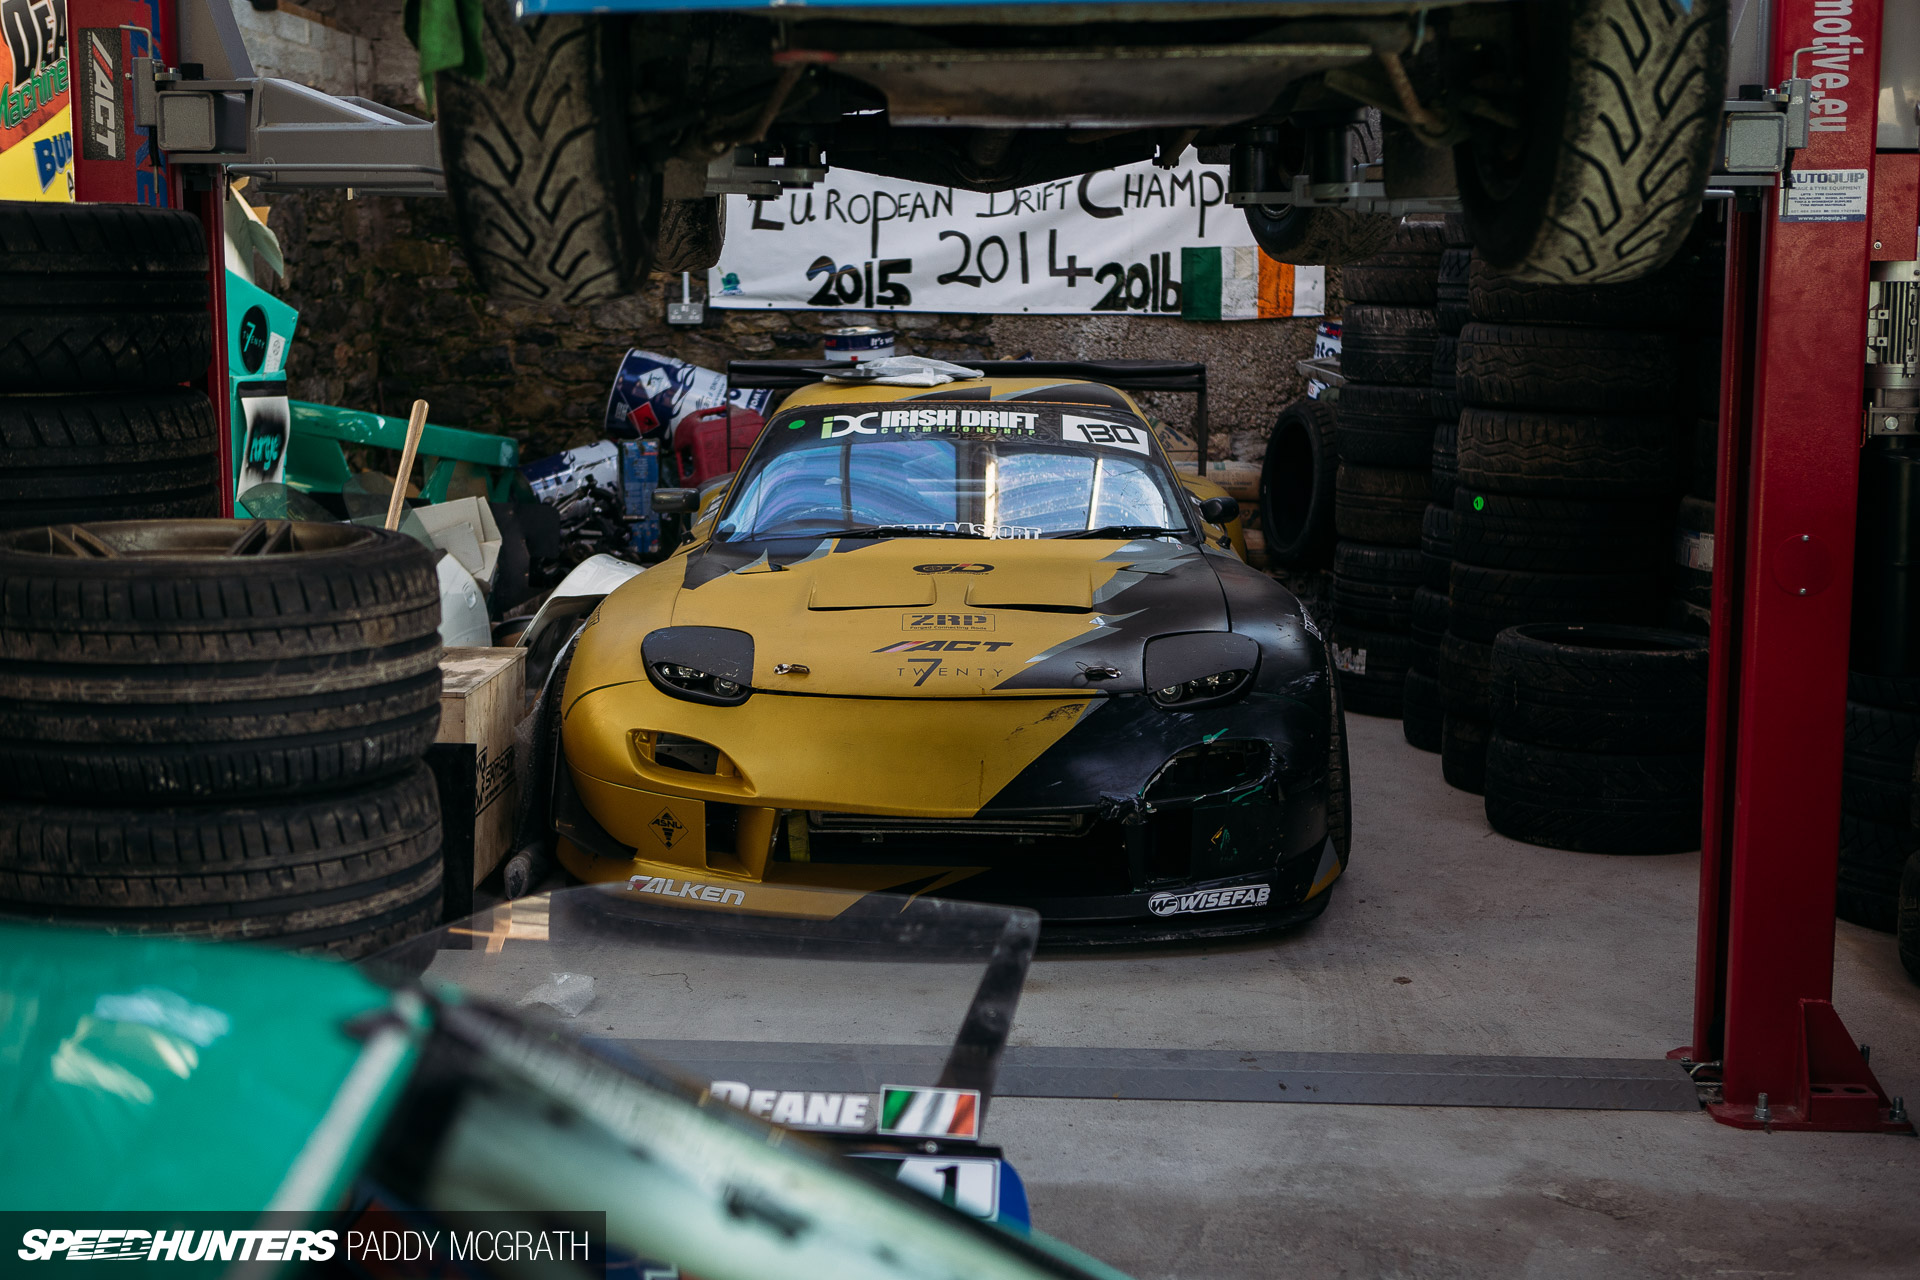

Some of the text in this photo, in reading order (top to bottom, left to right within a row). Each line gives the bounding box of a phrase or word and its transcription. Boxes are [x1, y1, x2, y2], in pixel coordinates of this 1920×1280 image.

[806, 255, 912, 308] 2015
[937, 229, 1093, 288] 2014
[880, 409, 956, 429] IRISH
[960, 411, 1040, 430] DRIFT
[1076, 423, 1141, 445] 130
[881, 426, 1037, 436] CHAMPIONSHIP
[910, 614, 988, 626] ZRP
[626, 874, 747, 907] FALKEN
[1180, 887, 1271, 911] WISEFAB
[710, 1080, 869, 1128] DEANE
